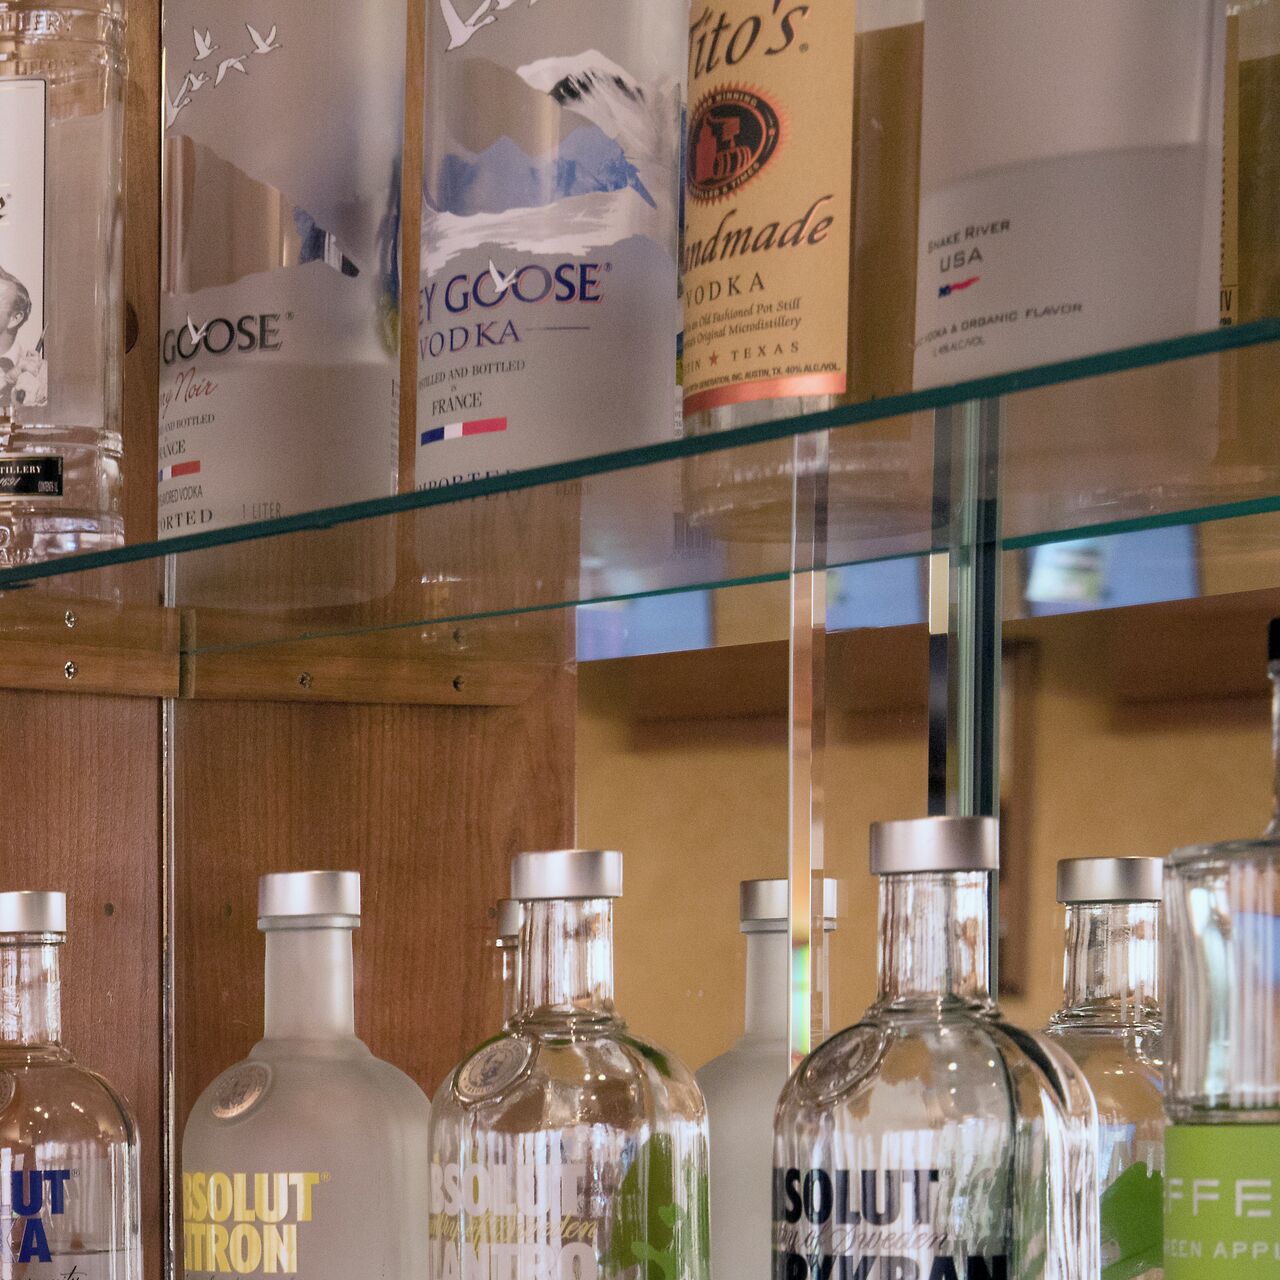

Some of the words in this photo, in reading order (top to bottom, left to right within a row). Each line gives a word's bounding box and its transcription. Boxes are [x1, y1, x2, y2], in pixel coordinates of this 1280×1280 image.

[927, 232, 961, 254] SNAKE
[964, 219, 1011, 241] RIVER
[939, 247, 983, 273] USA
[444, 262, 605, 315] GOOSE
[685, 271, 766, 309] VODKA
[698, 312, 712, 328] Old
[712, 304, 754, 325] Fashioned
[756, 302, 774, 314] Pot
[777, 297, 801, 311] Still
[961, 310, 1018, 332] ORGANIC
[1025, 303, 1083, 319] FLAVOR
[162, 313, 280, 366] GOOSE
[419, 319, 521, 362] VODKA
[696, 327, 726, 346] Original
[728, 316, 802, 337] Microdistillery
[730, 341, 800, 362] TEXAS
[175, 366, 218, 404] Noir
[448, 367, 469, 381] AND
[472, 359, 527, 376] BOTTLED
[431, 391, 483, 416] FRANCE
[175, 414, 215, 427] BOTTLED
[252, 503, 282, 519] LITER
